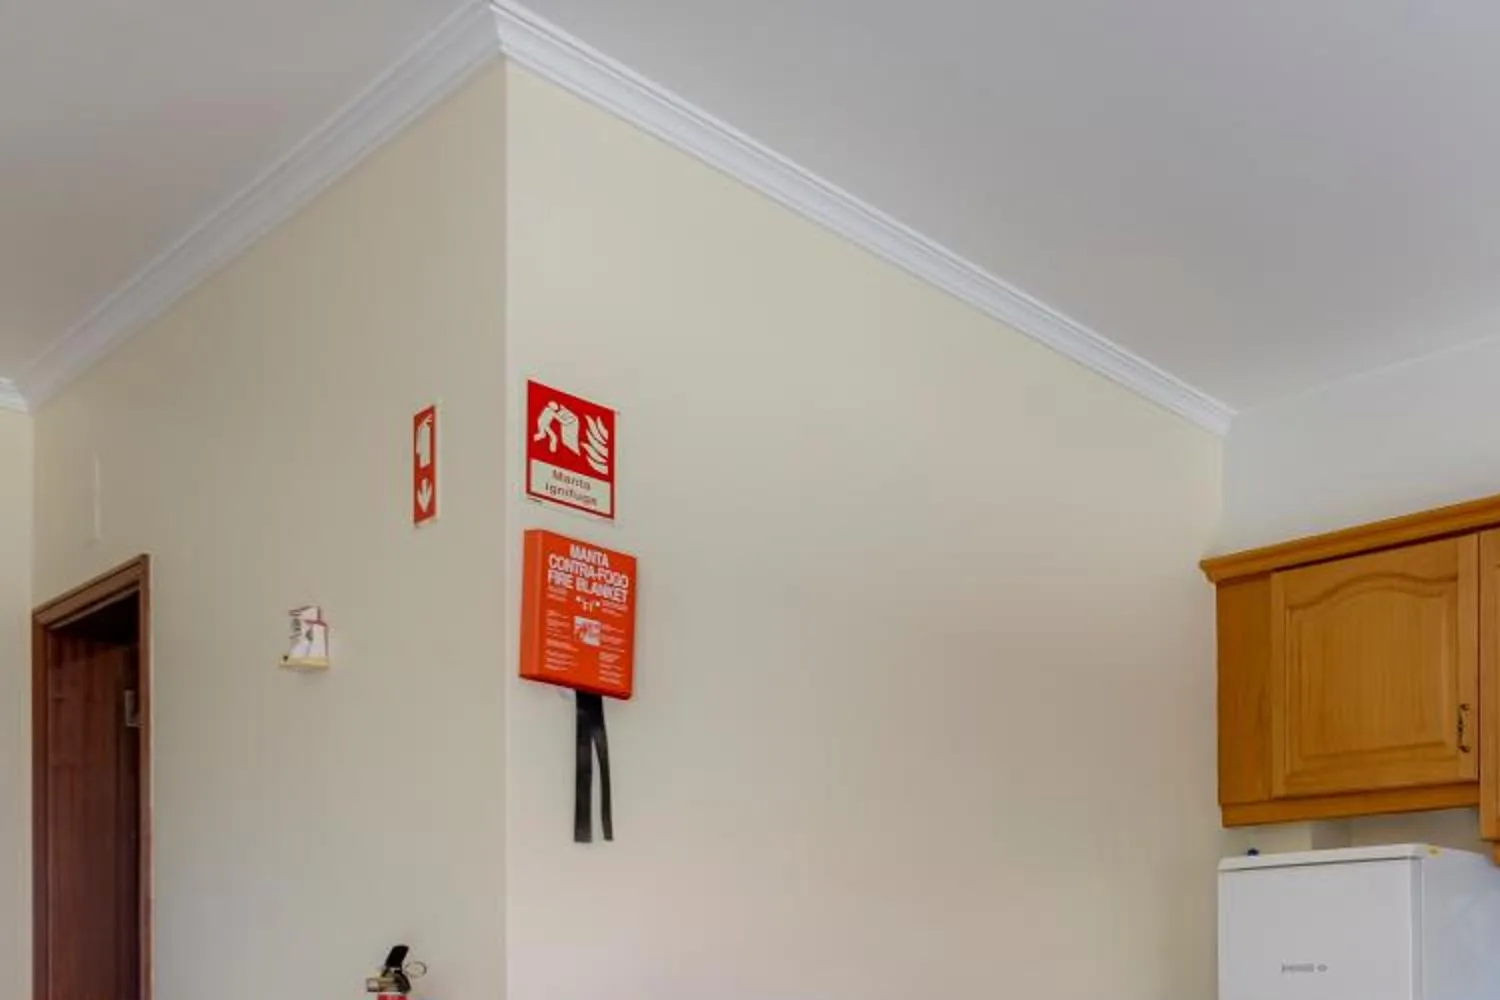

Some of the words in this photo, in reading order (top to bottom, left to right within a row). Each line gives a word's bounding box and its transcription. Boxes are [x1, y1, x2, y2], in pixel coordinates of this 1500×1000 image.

[570, 544, 609, 567] MANTA
[547, 569, 574, 590] FIRE
[576, 578, 628, 603] BLANKET
